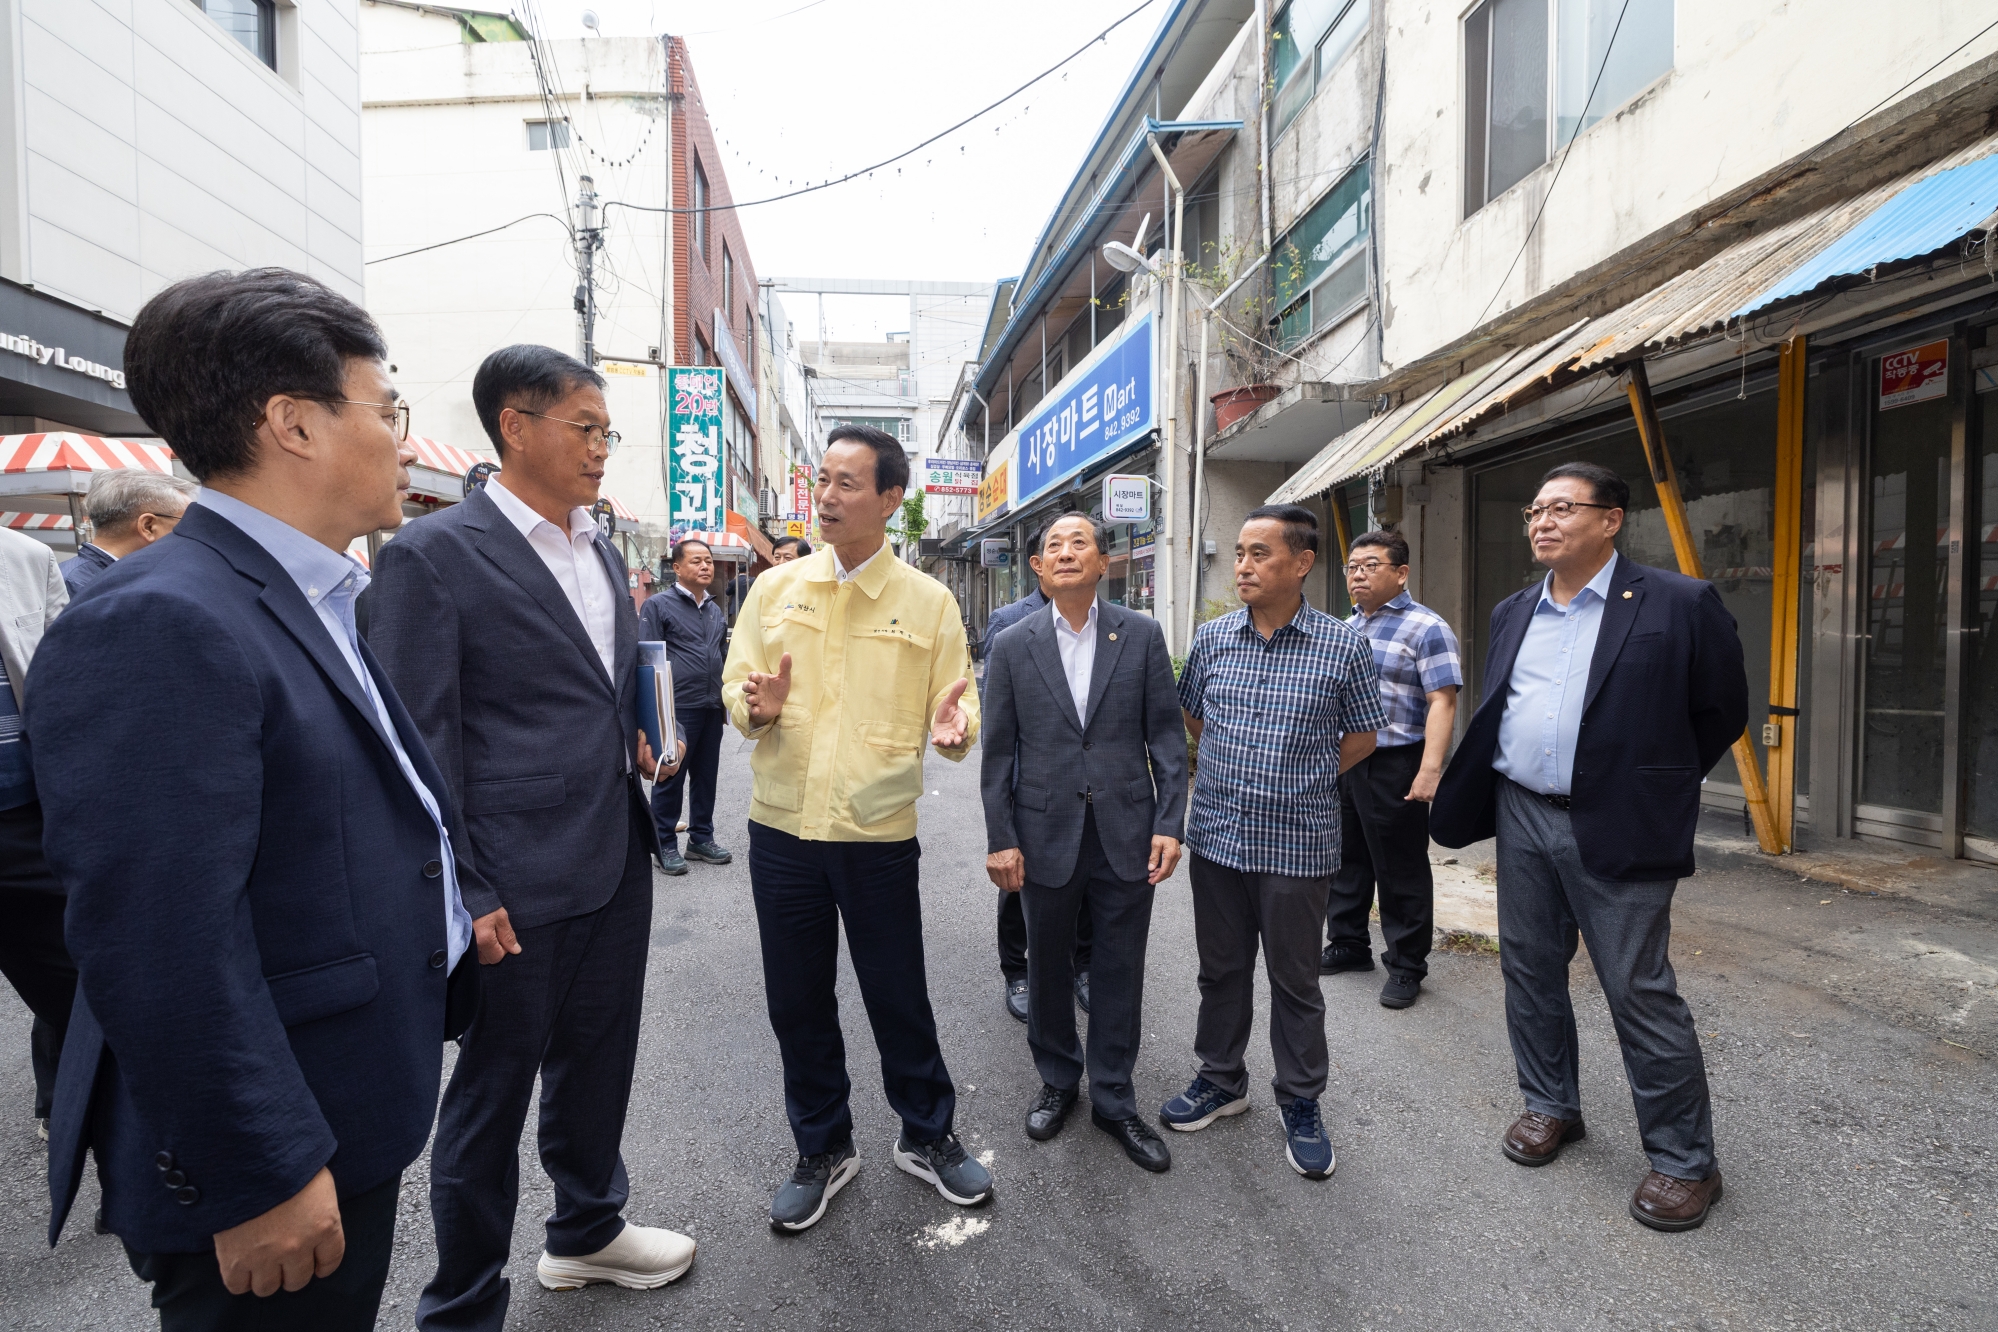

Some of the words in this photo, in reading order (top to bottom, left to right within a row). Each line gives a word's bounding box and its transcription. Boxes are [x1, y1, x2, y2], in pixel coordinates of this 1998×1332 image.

[55, 347, 125, 389] Loung
[1885, 351, 1920, 370] CCTV
[1885, 363, 1919, 379] 작동중
[675, 393, 718, 415] 20번
[1028, 383, 1100, 475] 시장마트
[1104, 376, 1136, 422] Mart
[1104, 406, 1141, 441] 842.9392
[673, 424, 722, 527] 청과
[930, 471, 953, 483] 송월
[940, 486, 972, 494] 852-5773
[1113, 490, 1144, 500] 시장마트
[598, 512, 610, 538] 05
[797, 603, 816, 614] 익산시
